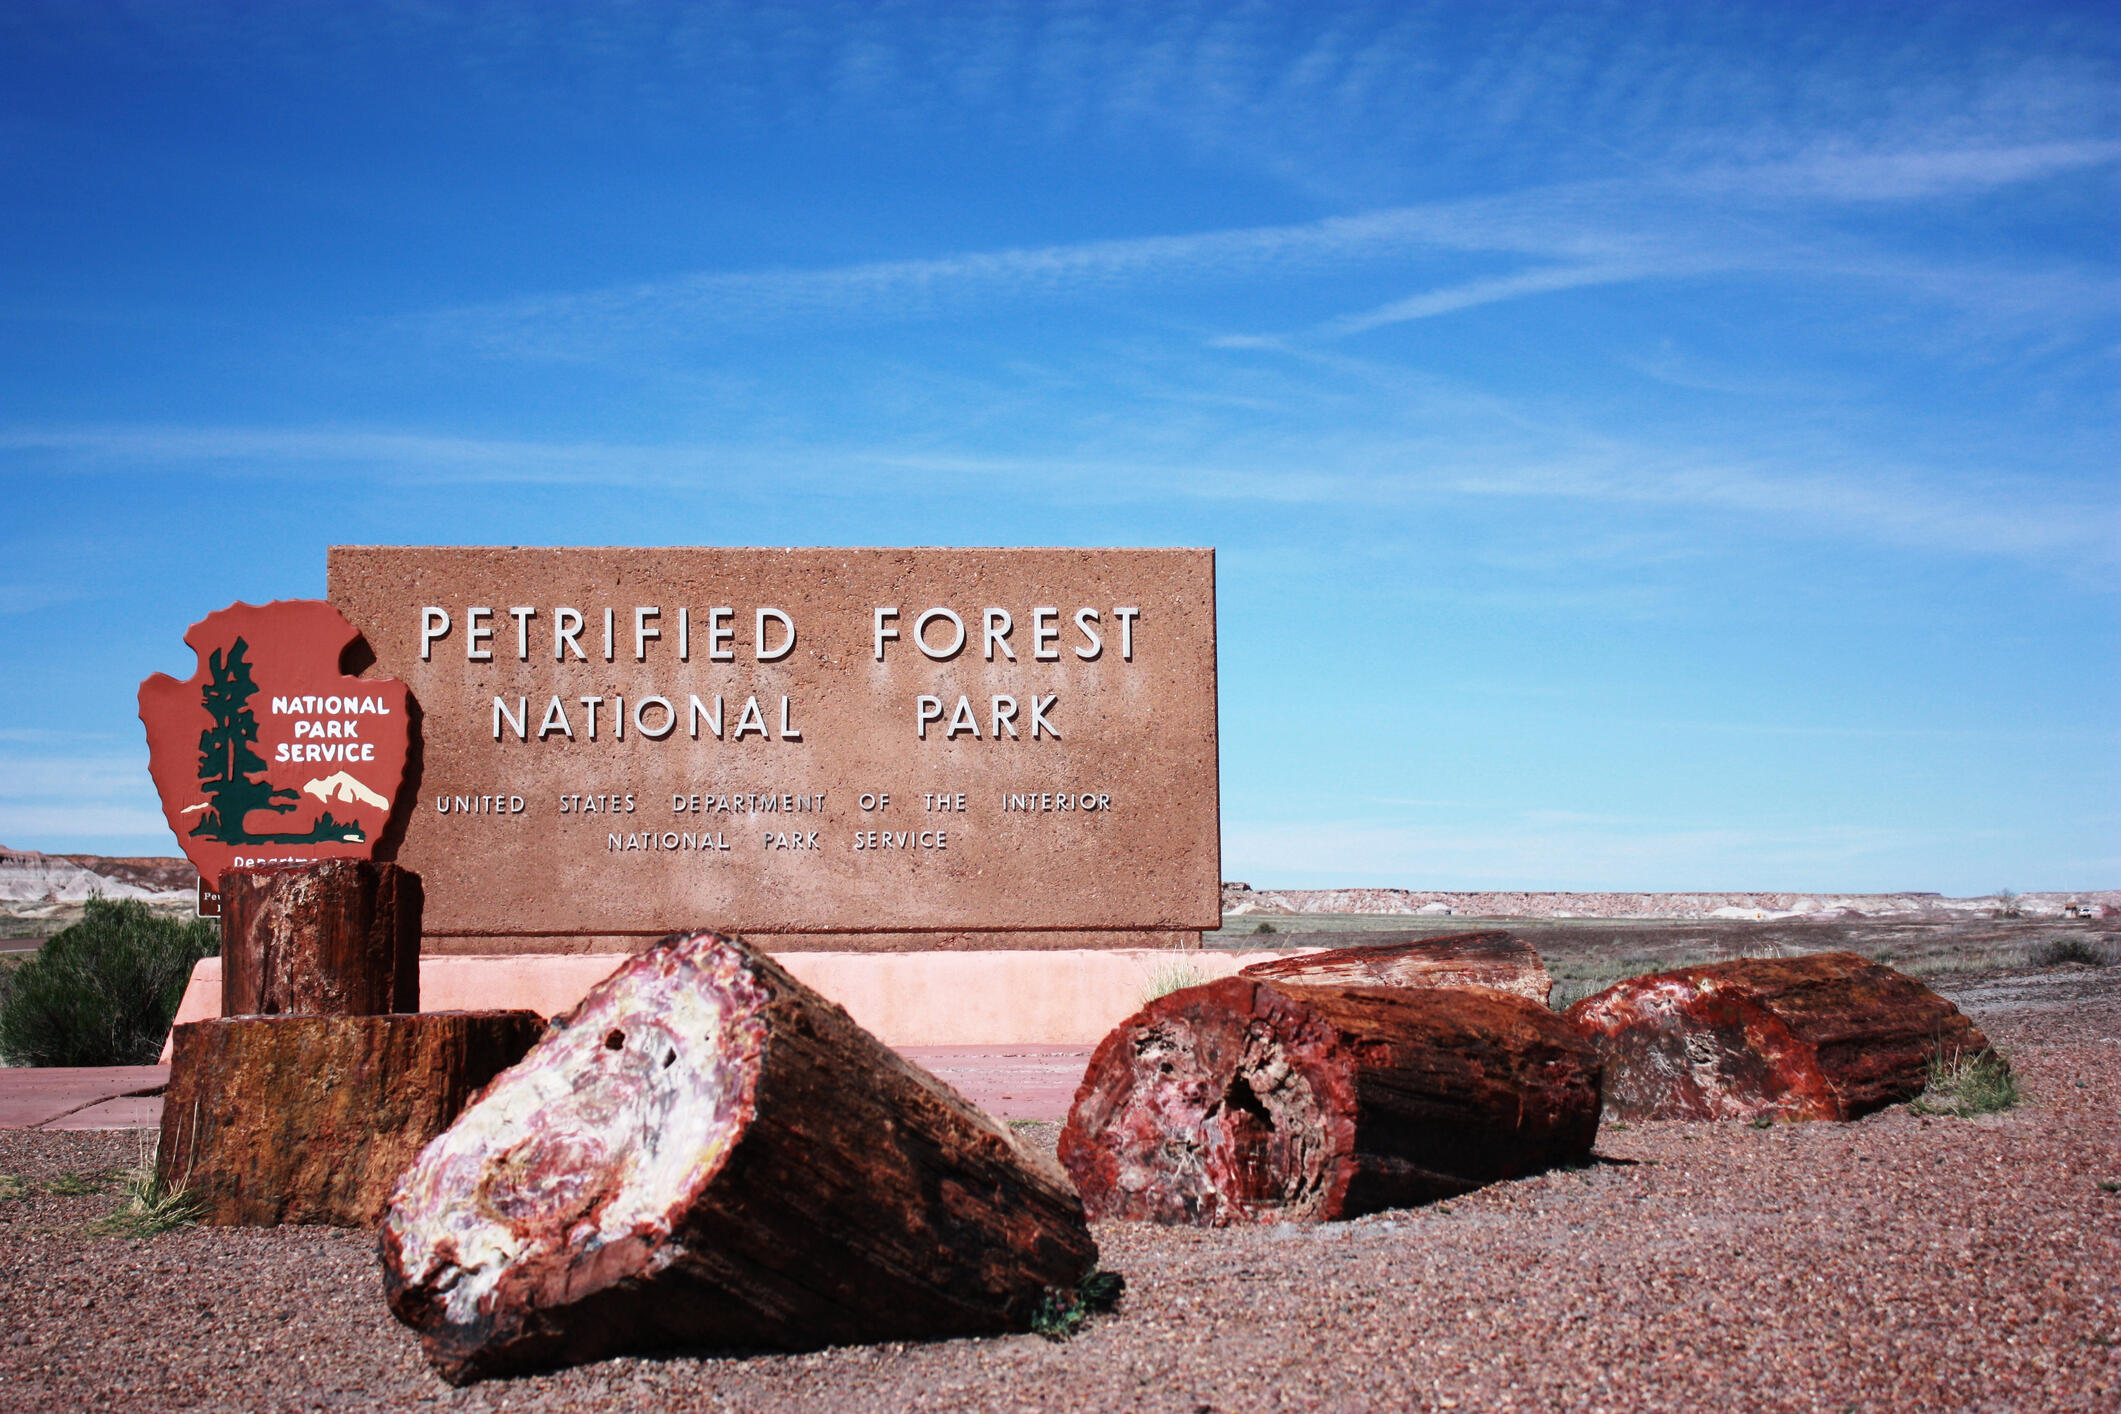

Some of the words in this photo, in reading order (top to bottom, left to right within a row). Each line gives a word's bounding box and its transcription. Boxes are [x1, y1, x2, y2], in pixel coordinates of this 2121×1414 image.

[421, 606, 796, 659] PETRIFIED
[873, 607, 1139, 660] FOREST
[272, 696, 390, 715] NATIONAL
[493, 695, 801, 738] NATIONAL
[917, 695, 1060, 738] PARK
[294, 720, 359, 739] PARK
[275, 743, 375, 763] SERVICE
[437, 795, 525, 813] UNITED
[560, 795, 635, 813] STATES
[673, 794, 825, 812] DEPARTMENT
[859, 794, 890, 811] OF
[925, 794, 966, 811] THE
[1002, 793, 1111, 811] INTERIOR
[608, 832, 730, 850] NATIONAL
[764, 832, 819, 849] PARK
[854, 831, 947, 849] SERVICE
